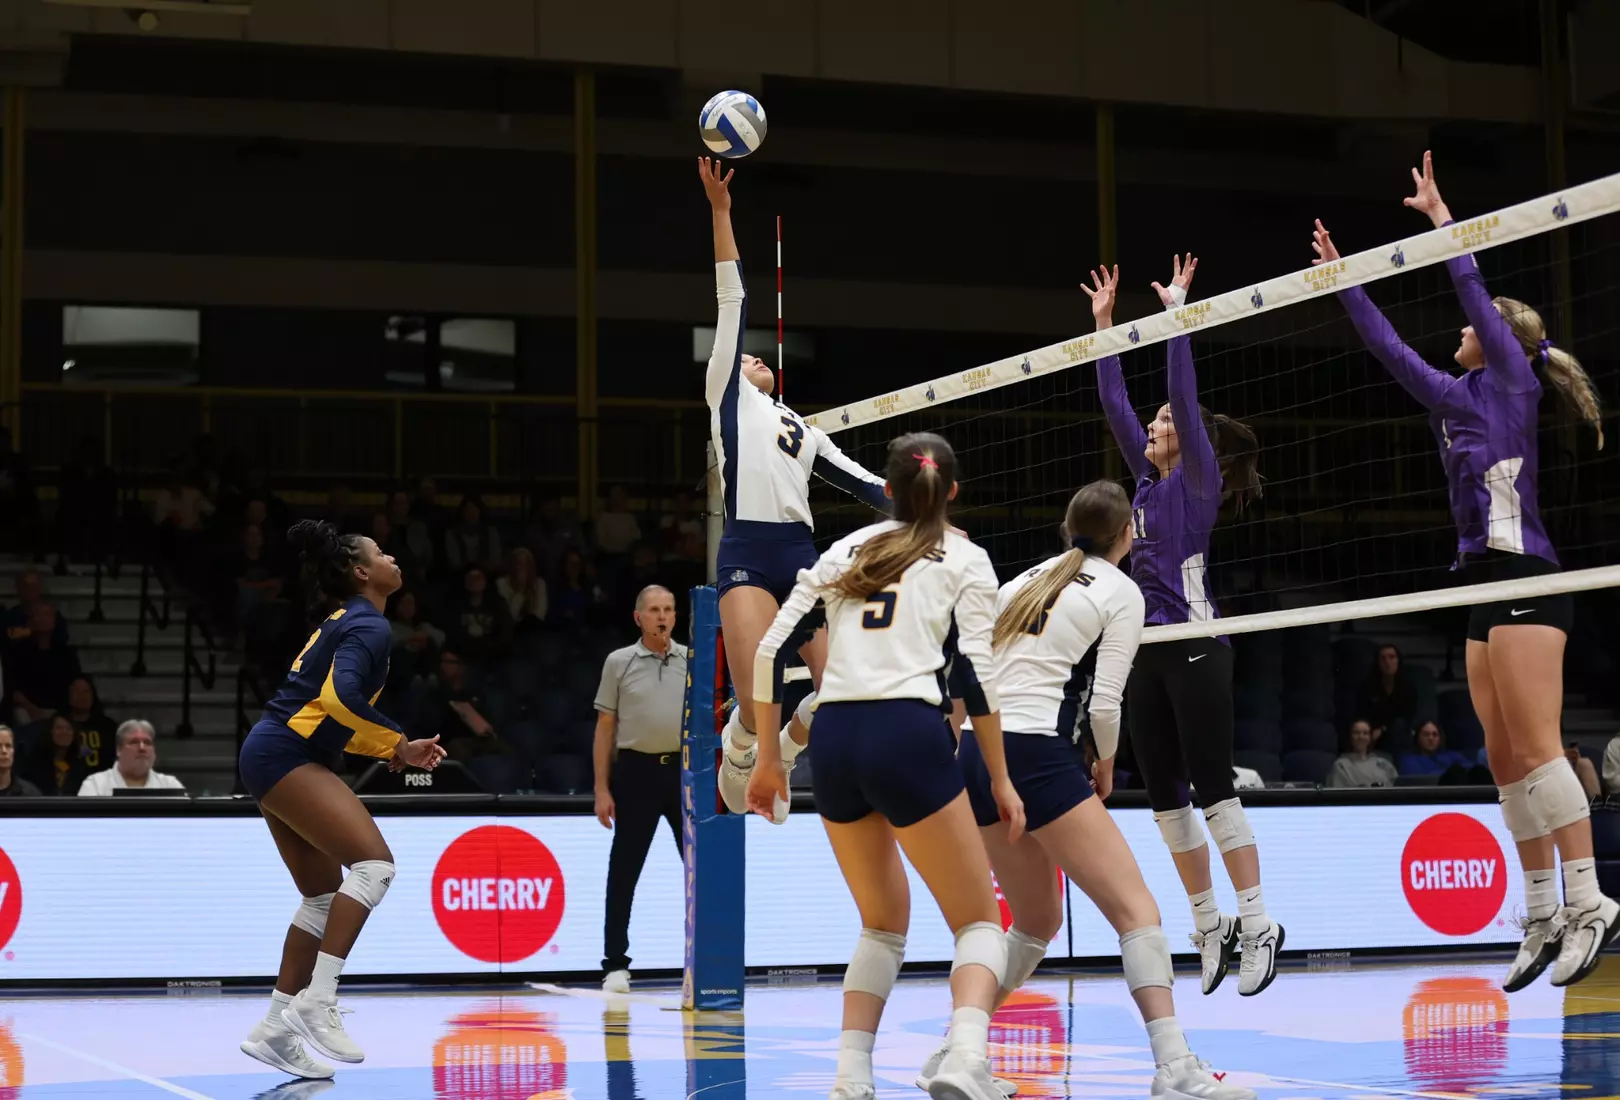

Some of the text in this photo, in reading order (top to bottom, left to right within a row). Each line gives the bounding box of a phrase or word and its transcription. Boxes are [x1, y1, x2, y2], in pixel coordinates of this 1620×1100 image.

[1451, 215, 1500, 240] KANSAS
[1462, 229, 1492, 249] CITY
[777, 415, 804, 459] 3
[862, 588, 897, 631] 5
[404, 774, 433, 787] POSS
[1410, 858, 1496, 890] CHERRY
[442, 877, 553, 911] CHERRY
